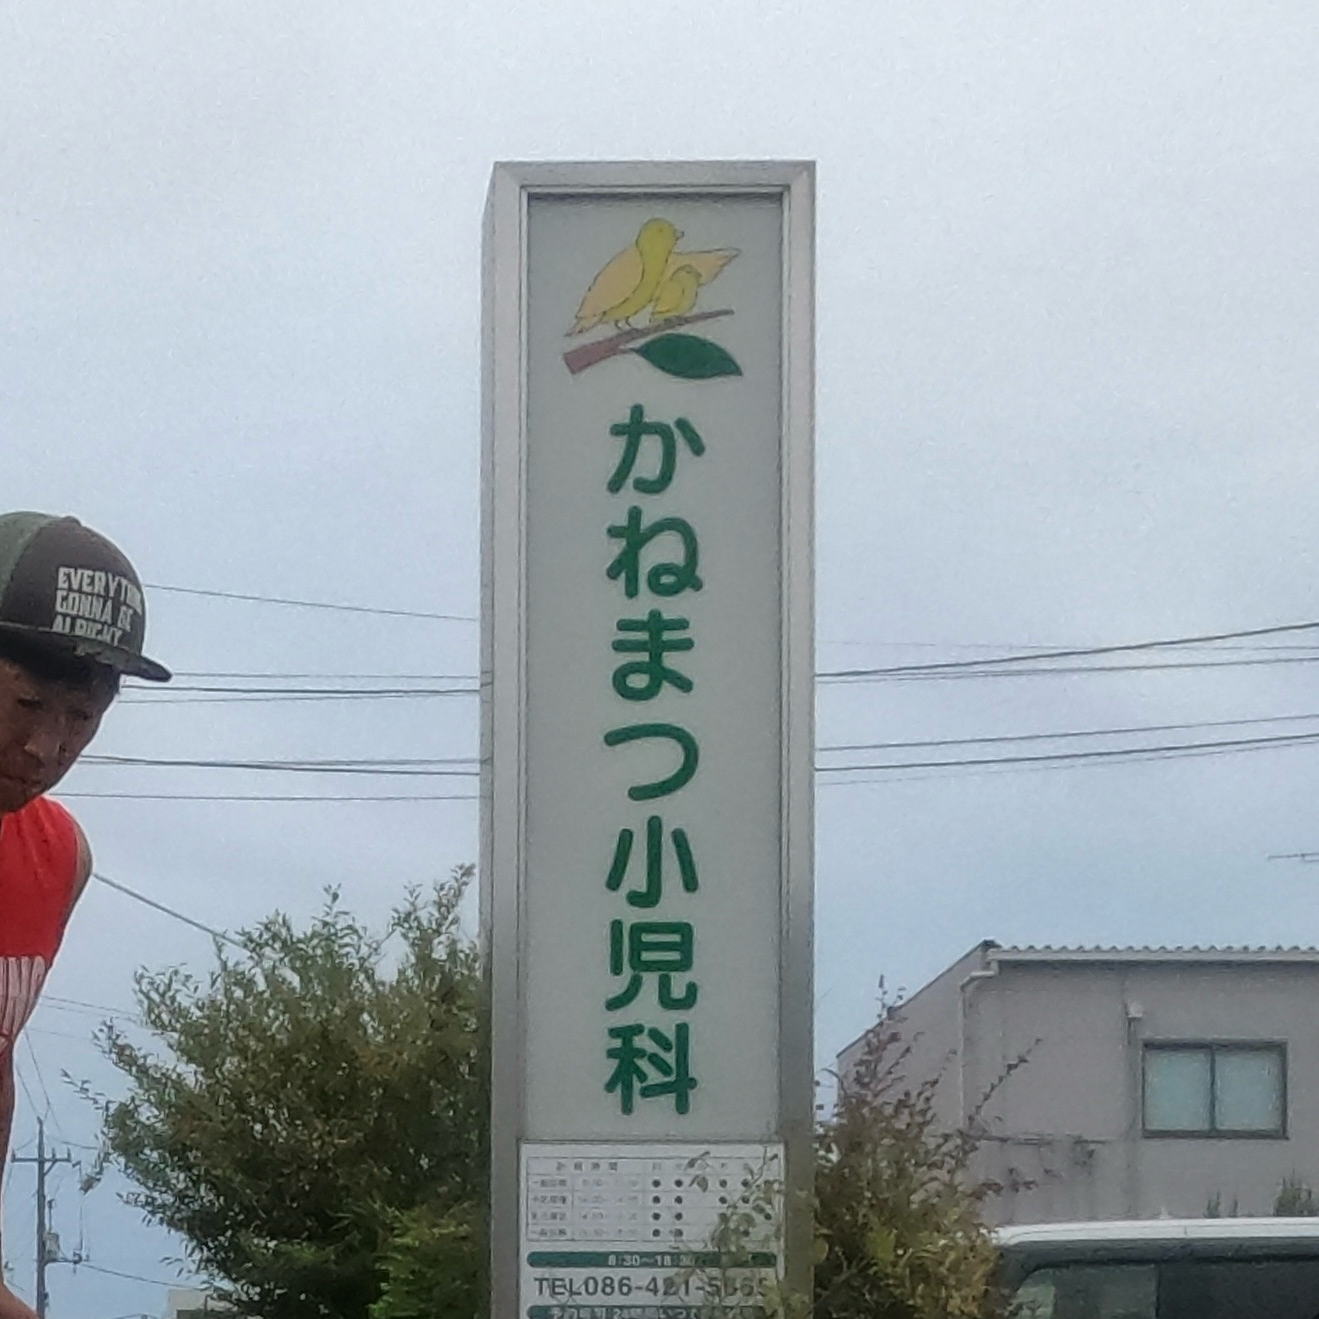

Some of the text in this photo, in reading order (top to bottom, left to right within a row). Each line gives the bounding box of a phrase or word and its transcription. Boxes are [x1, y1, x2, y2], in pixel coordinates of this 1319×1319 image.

[603, 402, 706, 1115] かねまつ小児科
